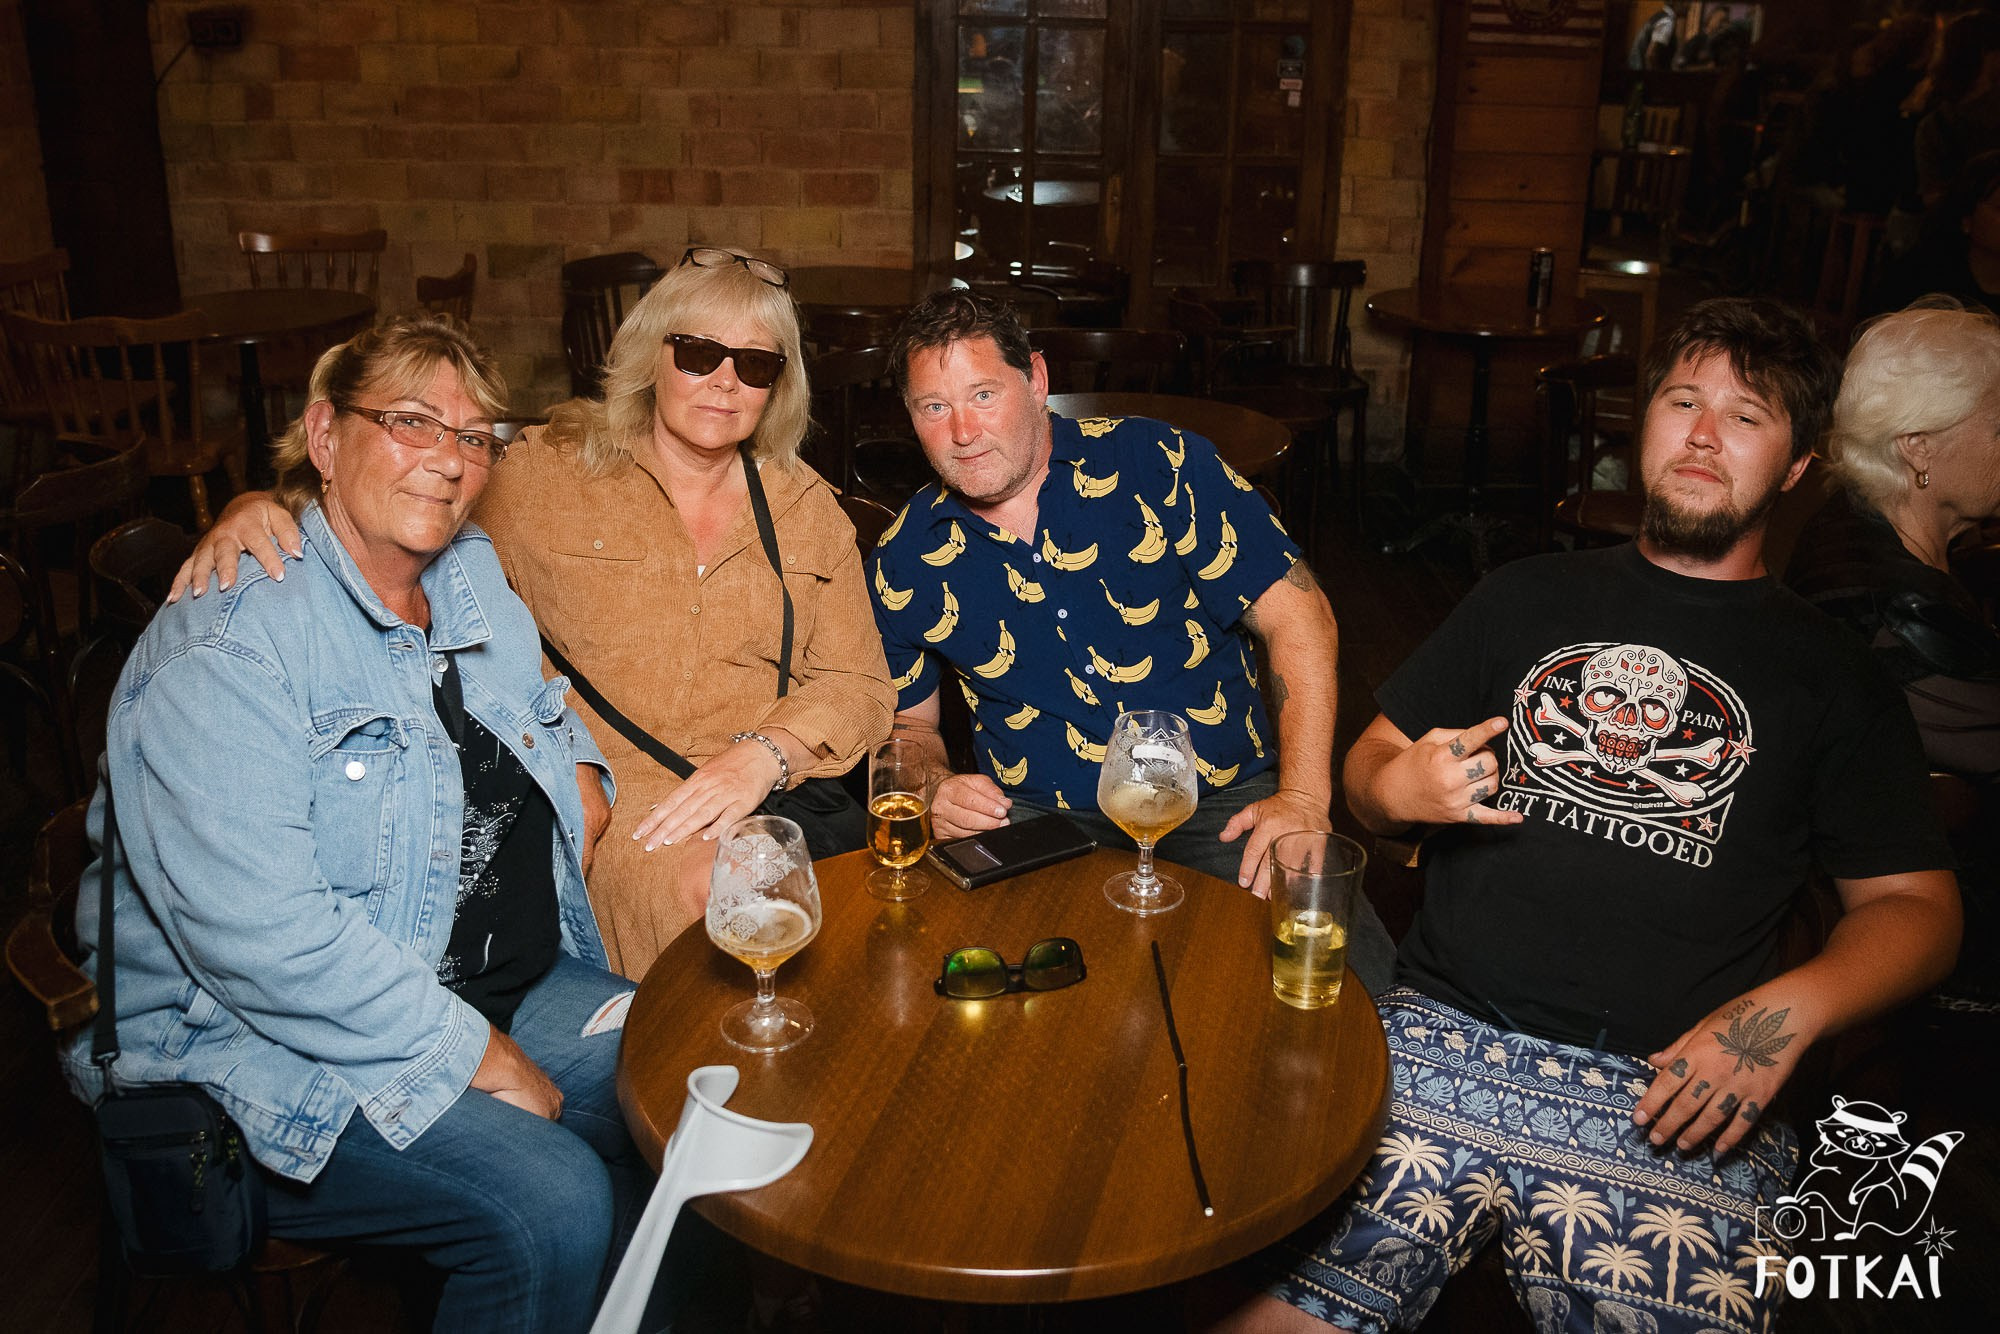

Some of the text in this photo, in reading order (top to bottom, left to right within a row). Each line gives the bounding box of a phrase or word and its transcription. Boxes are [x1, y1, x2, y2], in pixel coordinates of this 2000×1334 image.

[1543, 675, 1577, 693] INK
[1681, 710, 1725, 731] PAIN
[1496, 790, 1713, 868] GET TATTOOED
